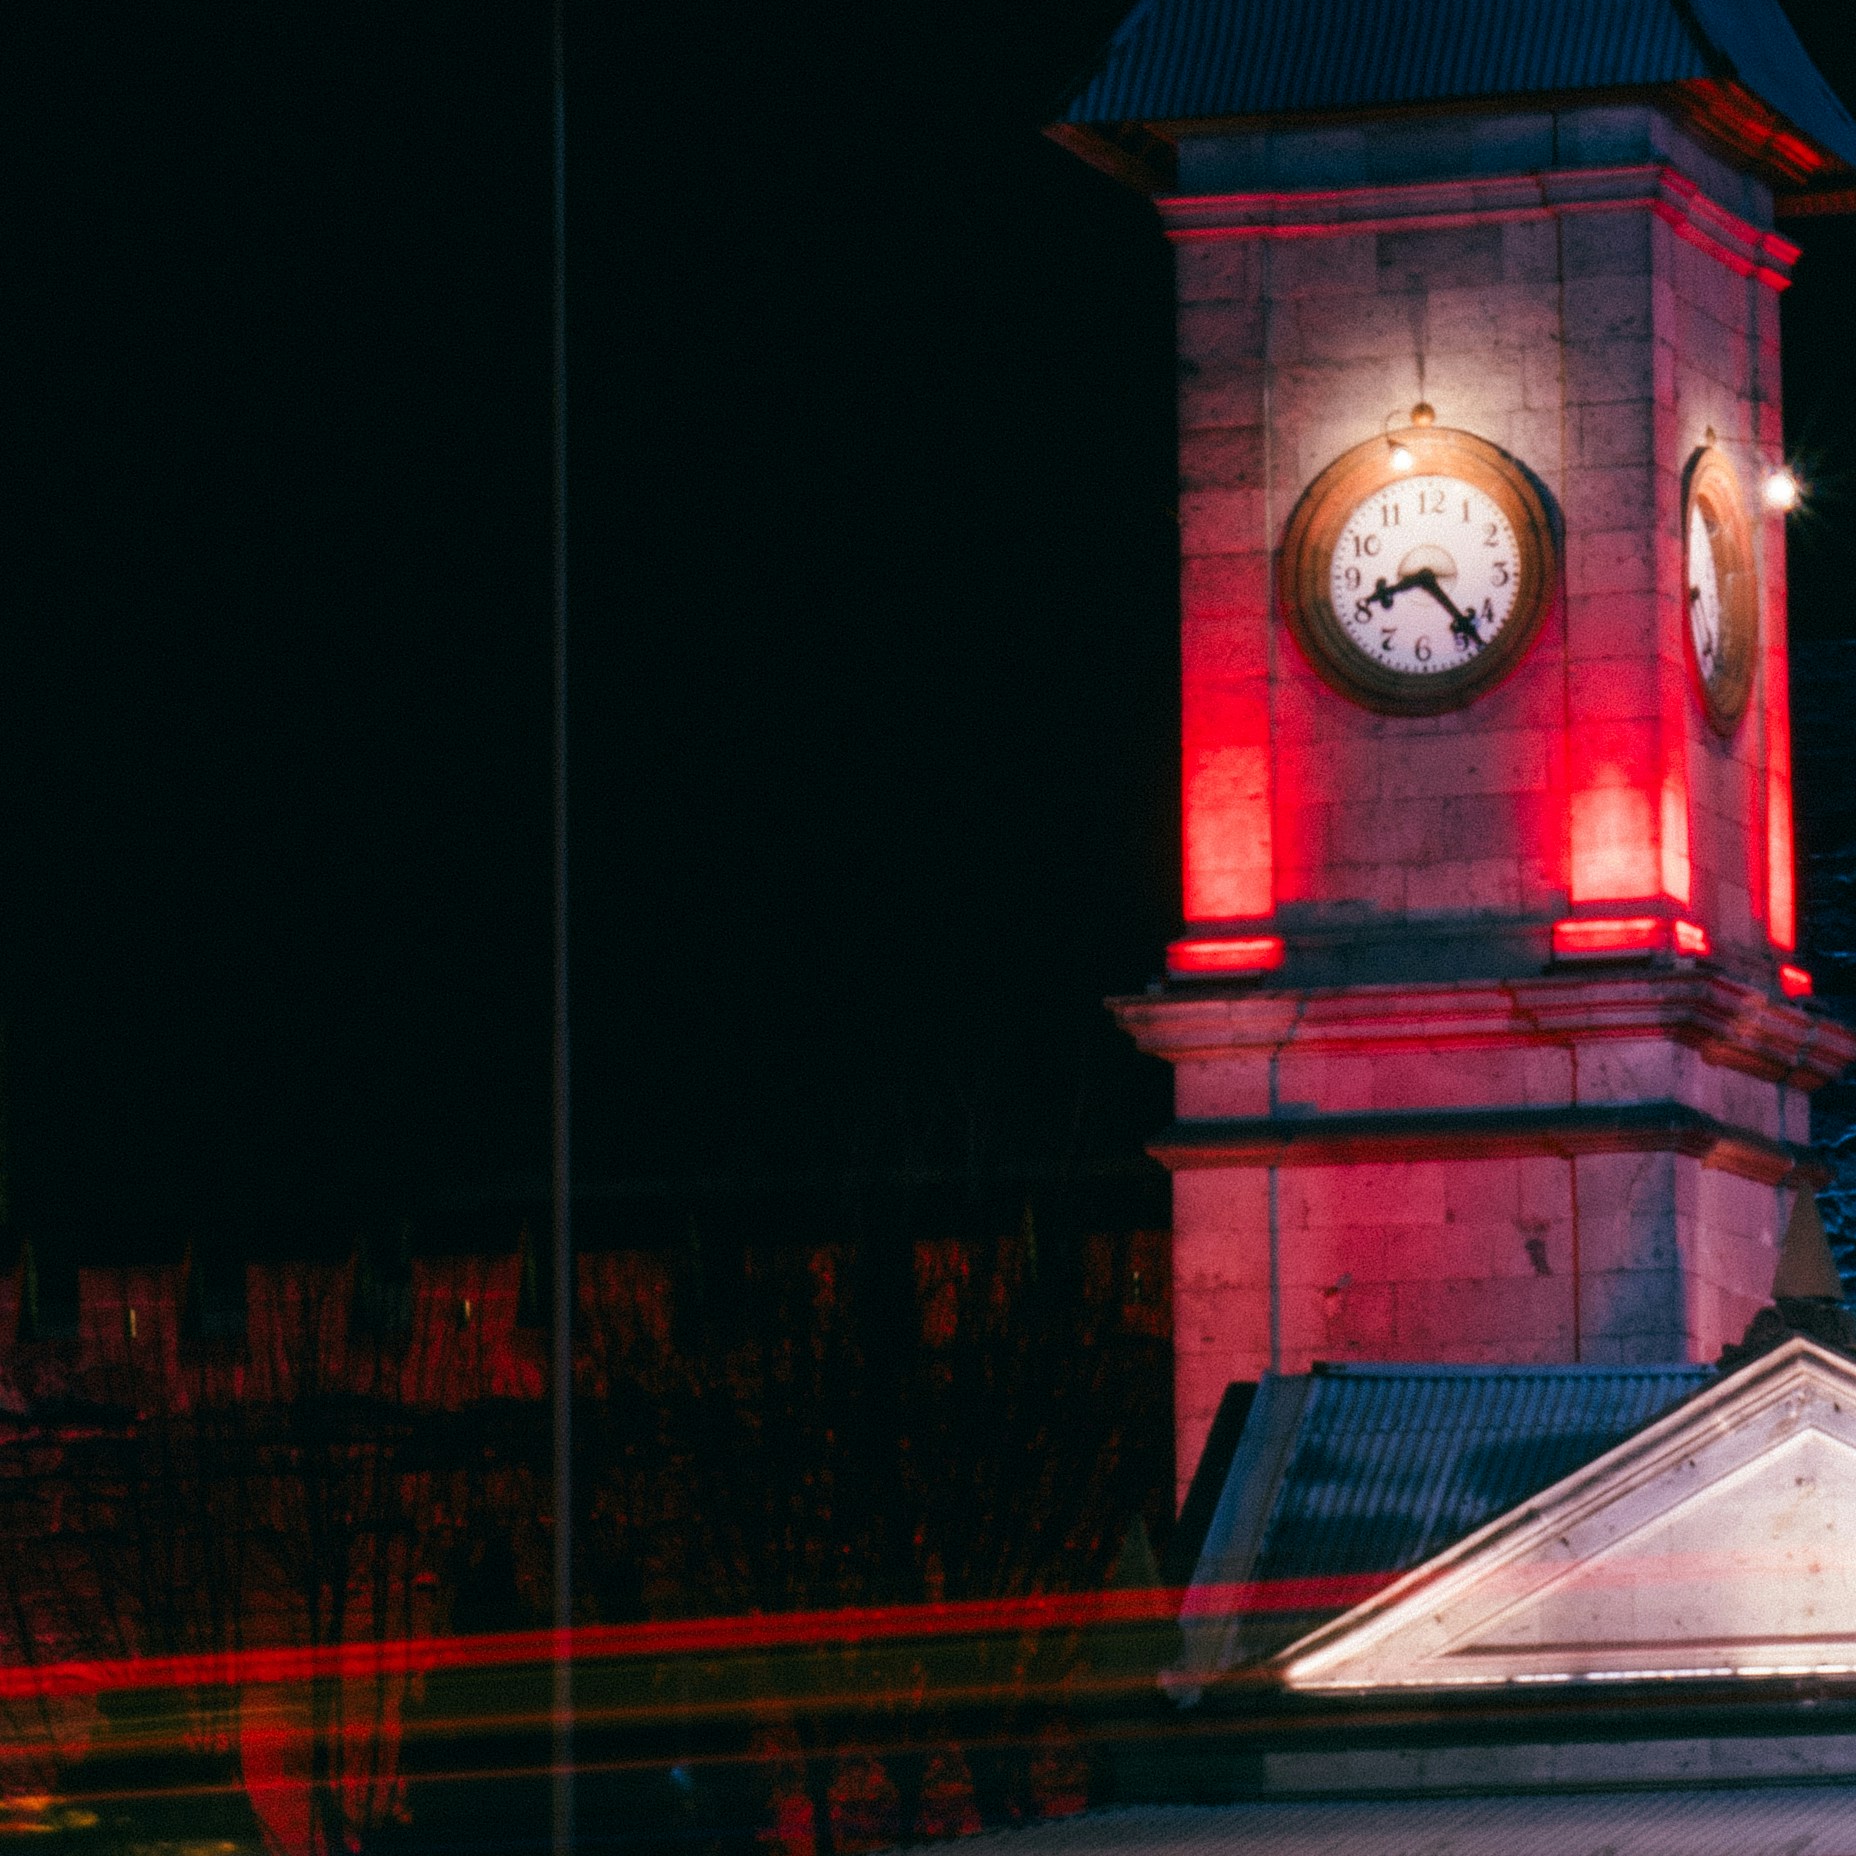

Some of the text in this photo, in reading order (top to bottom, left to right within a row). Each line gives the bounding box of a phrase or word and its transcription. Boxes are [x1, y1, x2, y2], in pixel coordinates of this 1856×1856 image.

[1418, 490, 1446, 515] 12
[1462, 497, 1470, 522] 1
[1381, 504, 1399, 527] 11
[1354, 534, 1381, 557] 10
[1483, 523, 1499, 547] 2
[1345, 566, 1361, 591] 9
[1491, 561, 1508, 587] 3
[1354, 597, 1373, 624] 8
[1481, 597, 1495, 623] 4
[1381, 626, 1398, 651] 7
[1414, 634, 1432, 662] 6
